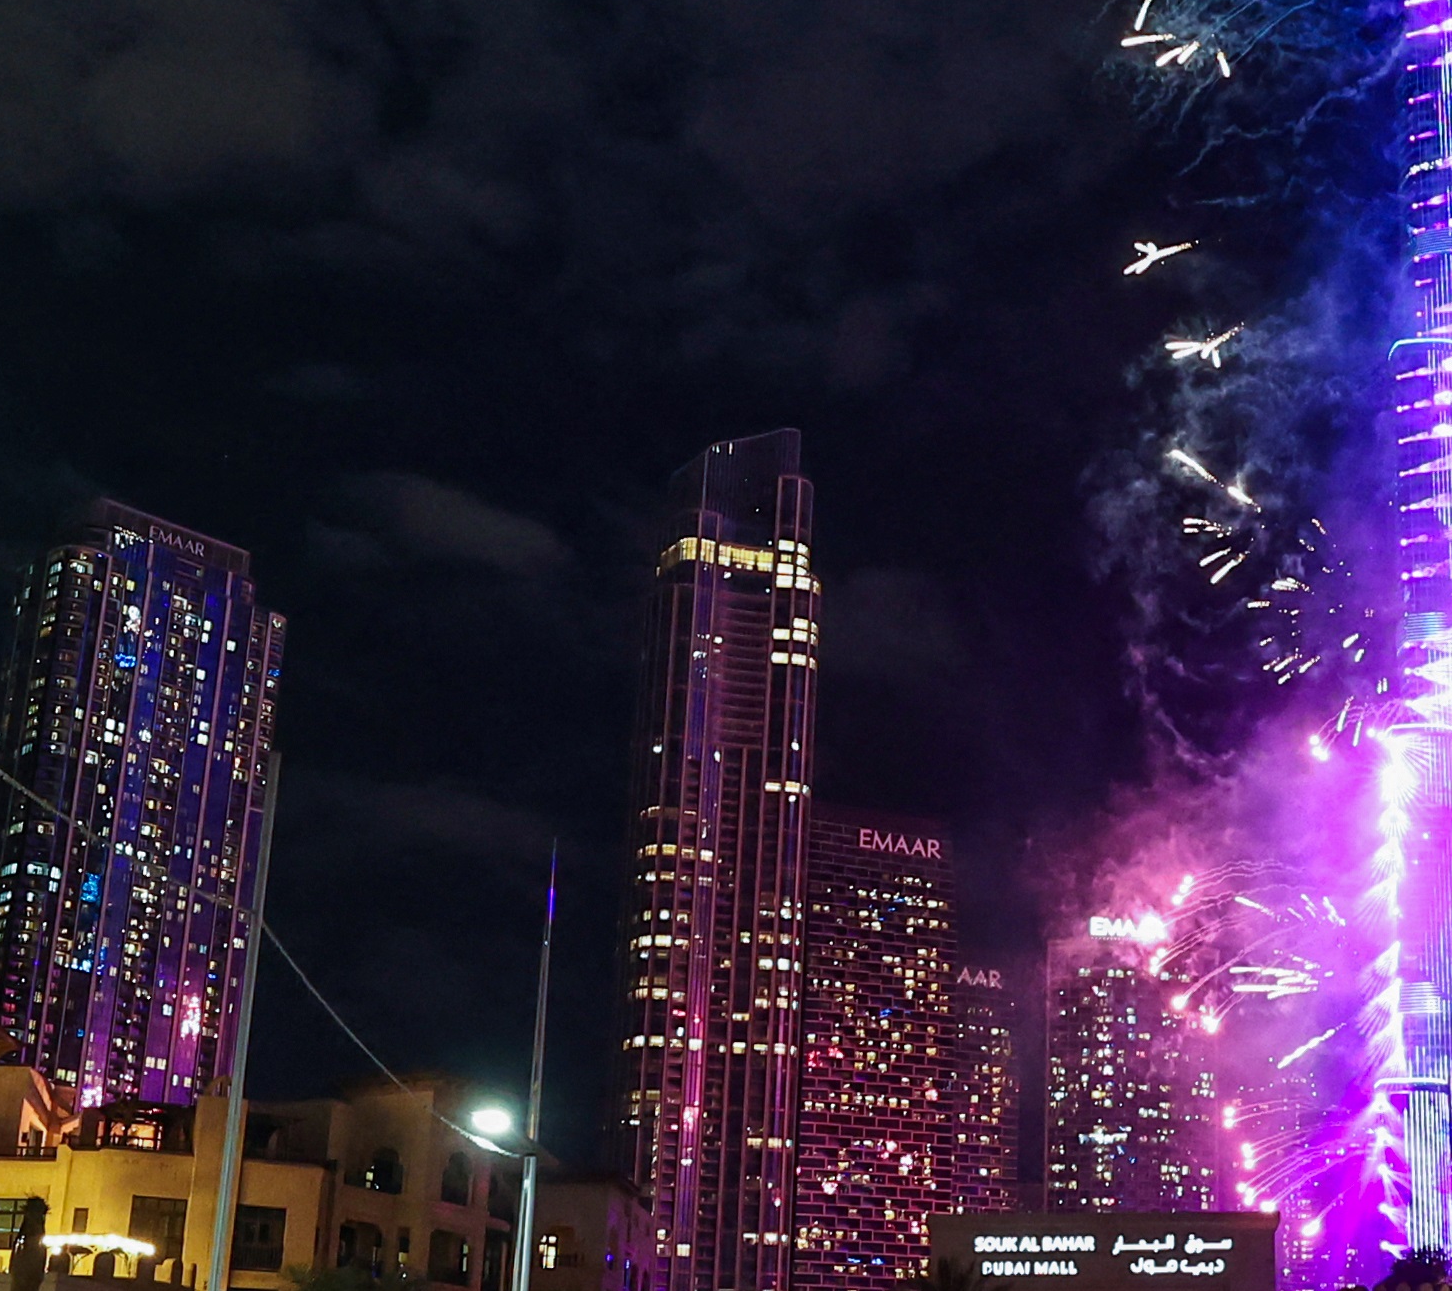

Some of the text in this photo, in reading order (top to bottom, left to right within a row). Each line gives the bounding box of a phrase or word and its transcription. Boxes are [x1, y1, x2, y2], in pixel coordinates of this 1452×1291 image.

[149, 525, 205, 558] EMAAR
[859, 828, 942, 859] EMAAR
[956, 966, 1003, 990] AAR
[974, 1236, 1095, 1252] SOUK AL BAHAR
[982, 1260, 1078, 1275] DUBAI MALL
